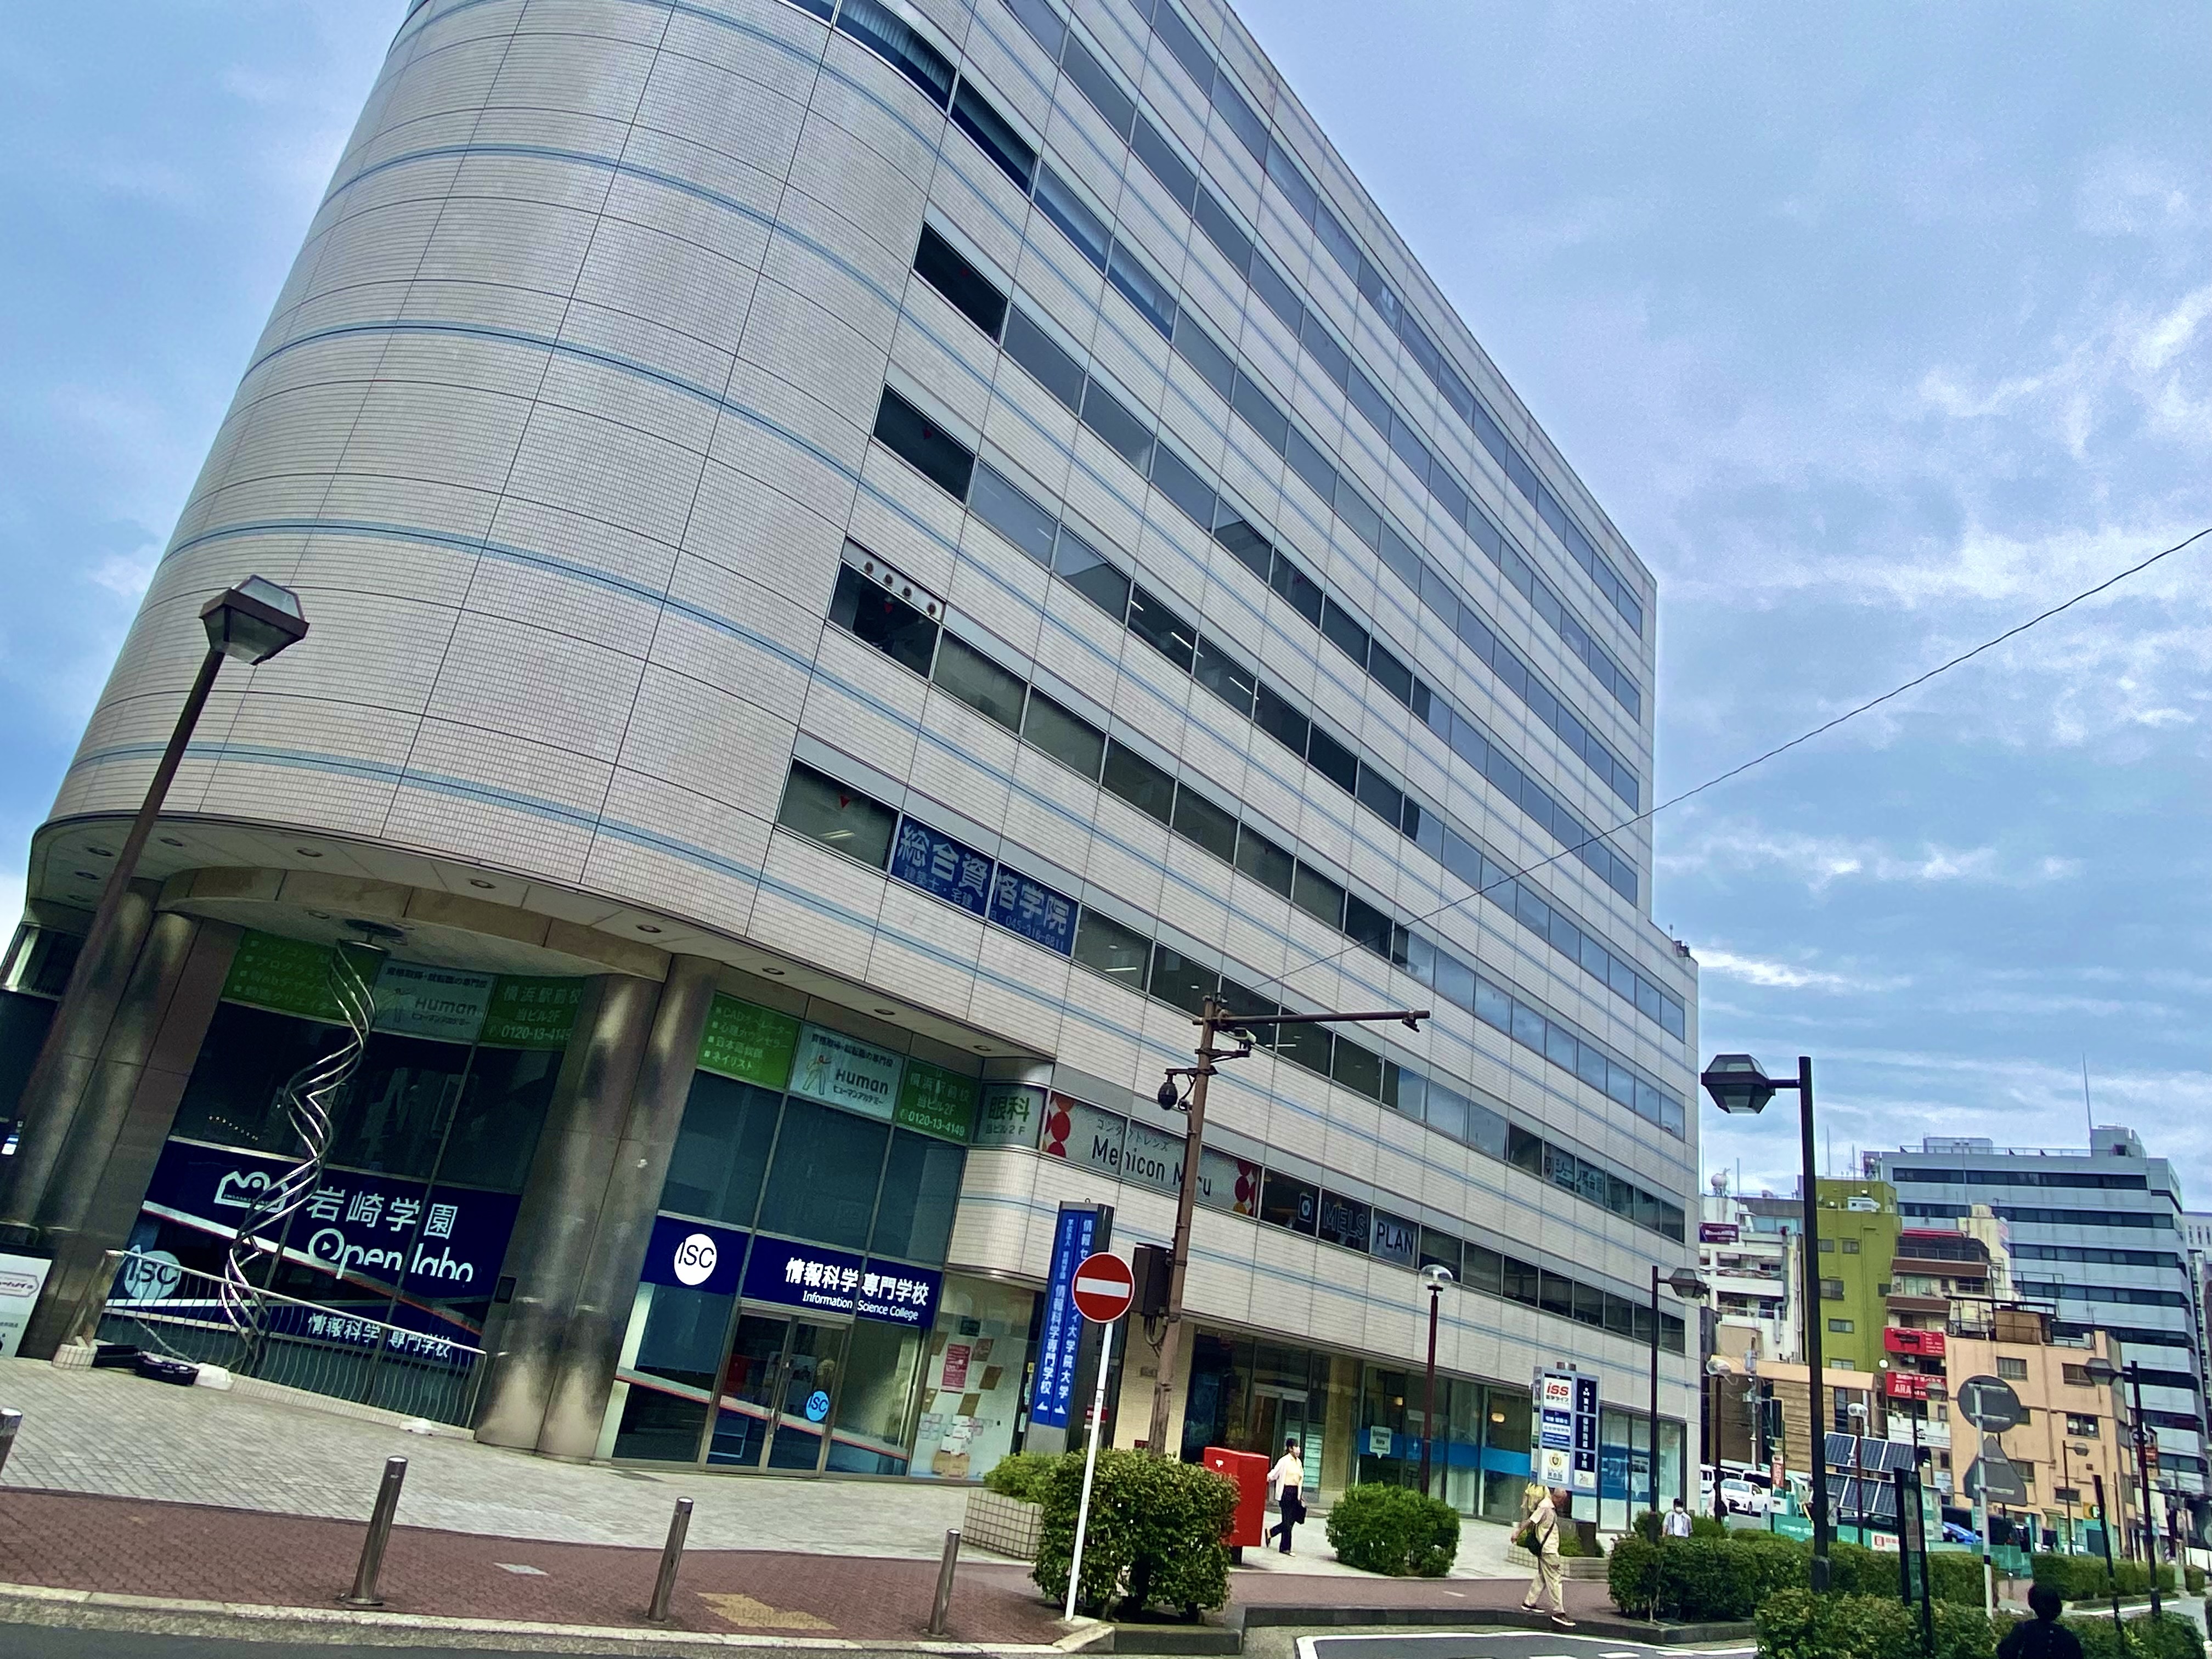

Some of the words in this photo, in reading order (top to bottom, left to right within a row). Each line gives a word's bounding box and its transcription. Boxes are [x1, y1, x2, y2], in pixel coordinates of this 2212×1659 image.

[897, 825, 1069, 935] 総合資格学院
[1006, 915, 1064, 951] 045-316-6811
[415, 997, 477, 1016] Human
[713, 1051, 752, 1070] ネイリスト
[836, 1069, 889, 1095] Human
[909, 1110, 965, 1137] 0120-13-4149
[989, 1097, 1029, 1122] 眼科
[307, 1186, 458, 1239] 岩崎学園
[1376, 1222, 1413, 1255] PLAN
[128, 1251, 178, 1284] ISC
[308, 1228, 402, 1279] Open
[679, 1239, 714, 1268] ISC
[802, 1290, 853, 1309] Information
[857, 1300, 888, 1315] Science
[890, 1306, 919, 1321] College
[809, 1393, 828, 1413] ISC
[1547, 1383, 1569, 1396] iss
